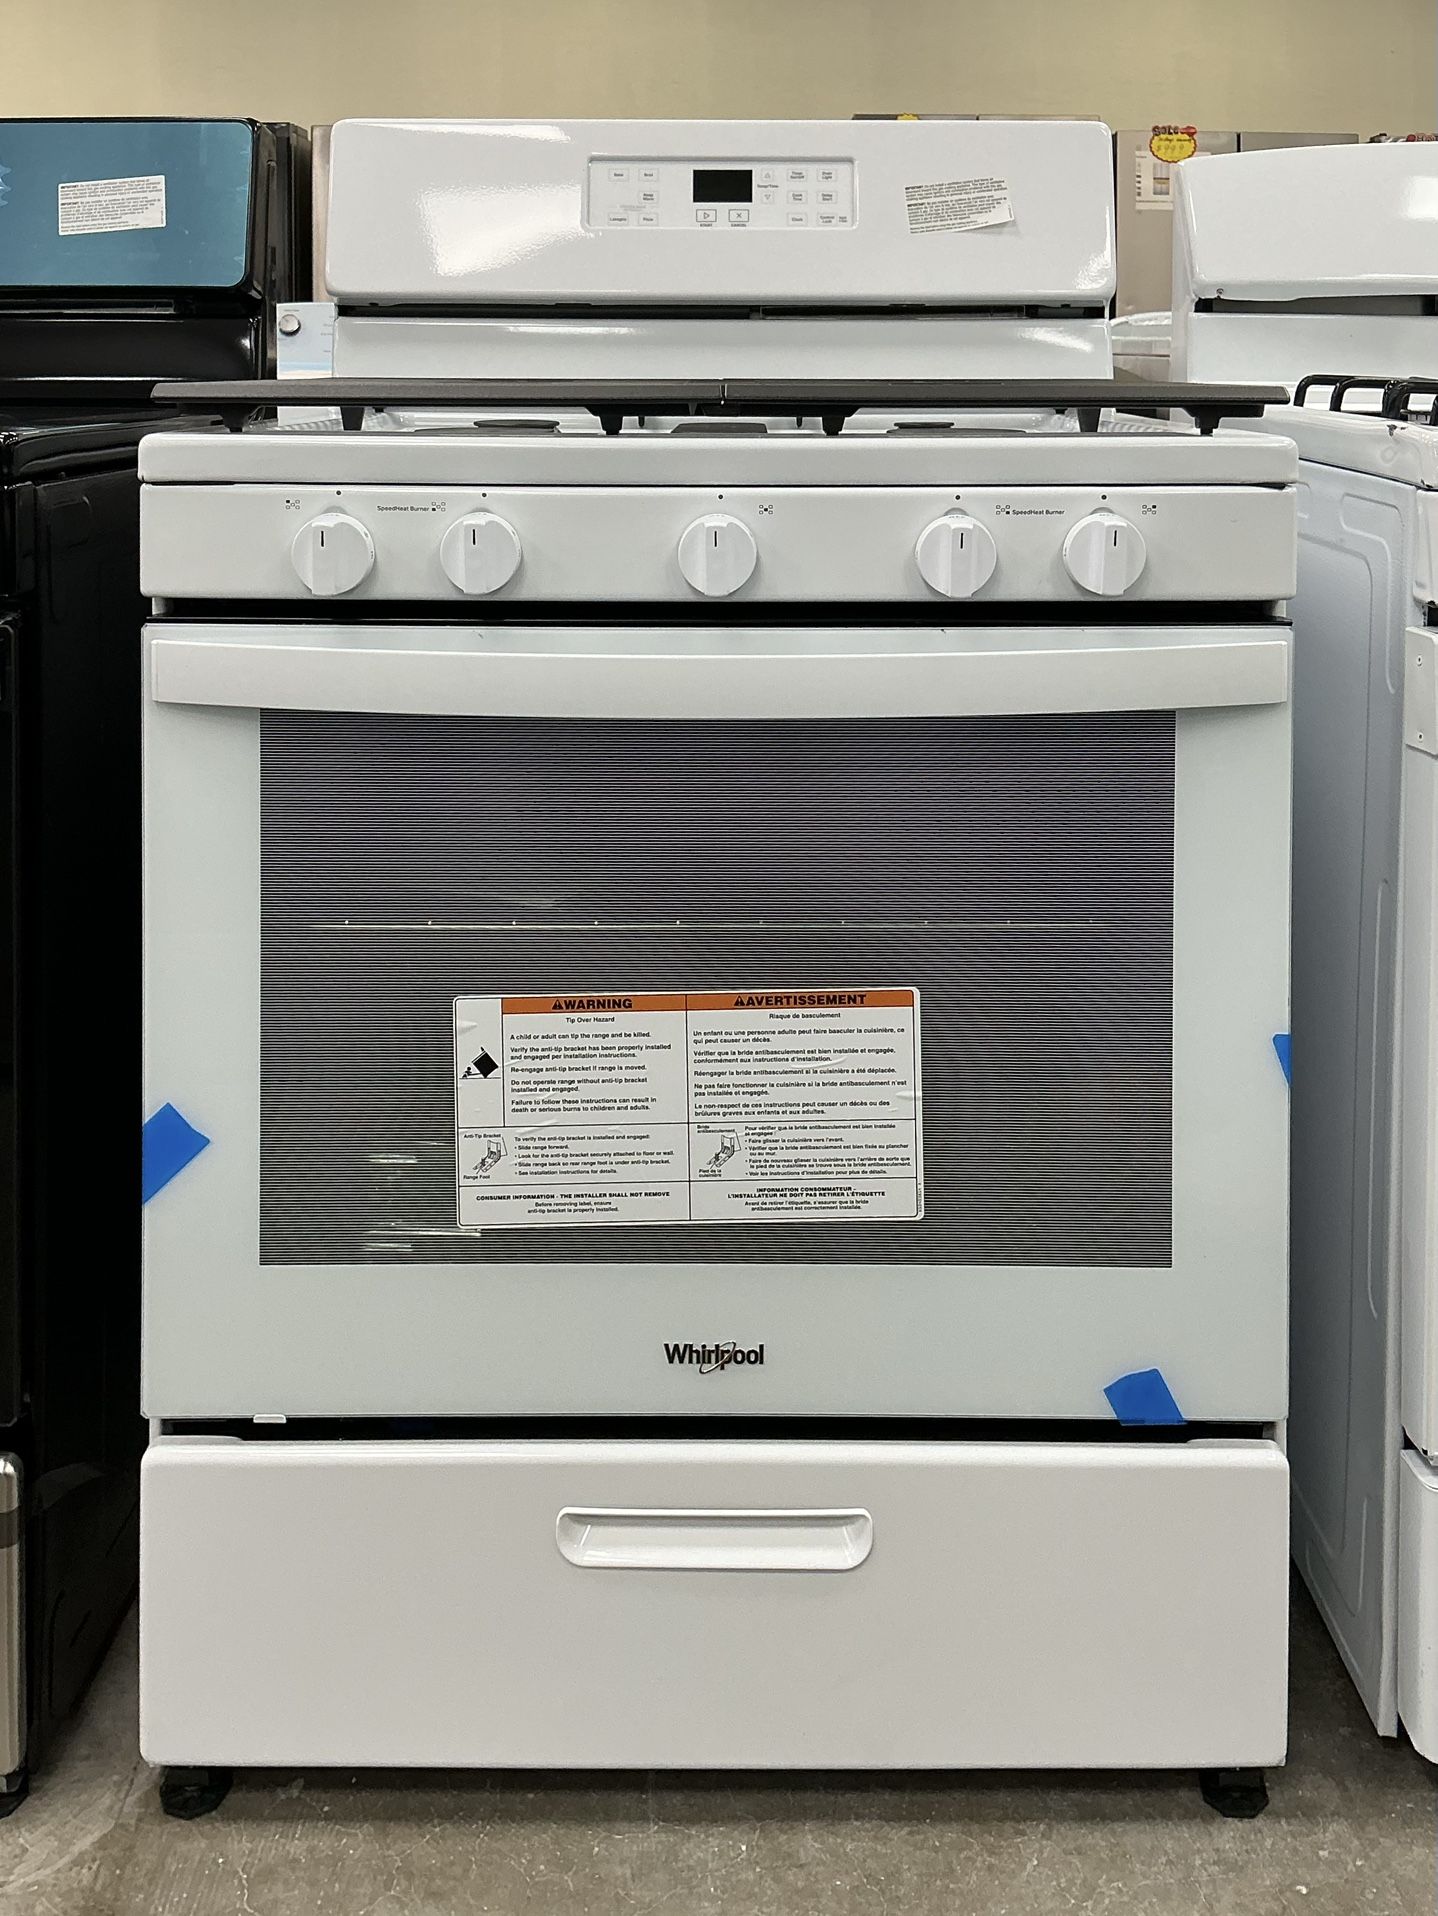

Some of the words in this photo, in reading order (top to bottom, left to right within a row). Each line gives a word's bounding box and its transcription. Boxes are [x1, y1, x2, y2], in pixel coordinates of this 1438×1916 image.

[564, 998, 632, 1010] WARNING
[746, 994, 866, 1006] AVERTISSEMENT
[693, 1056, 738, 1064] conformément
[664, 1342, 764, 1372] Whirlpool
